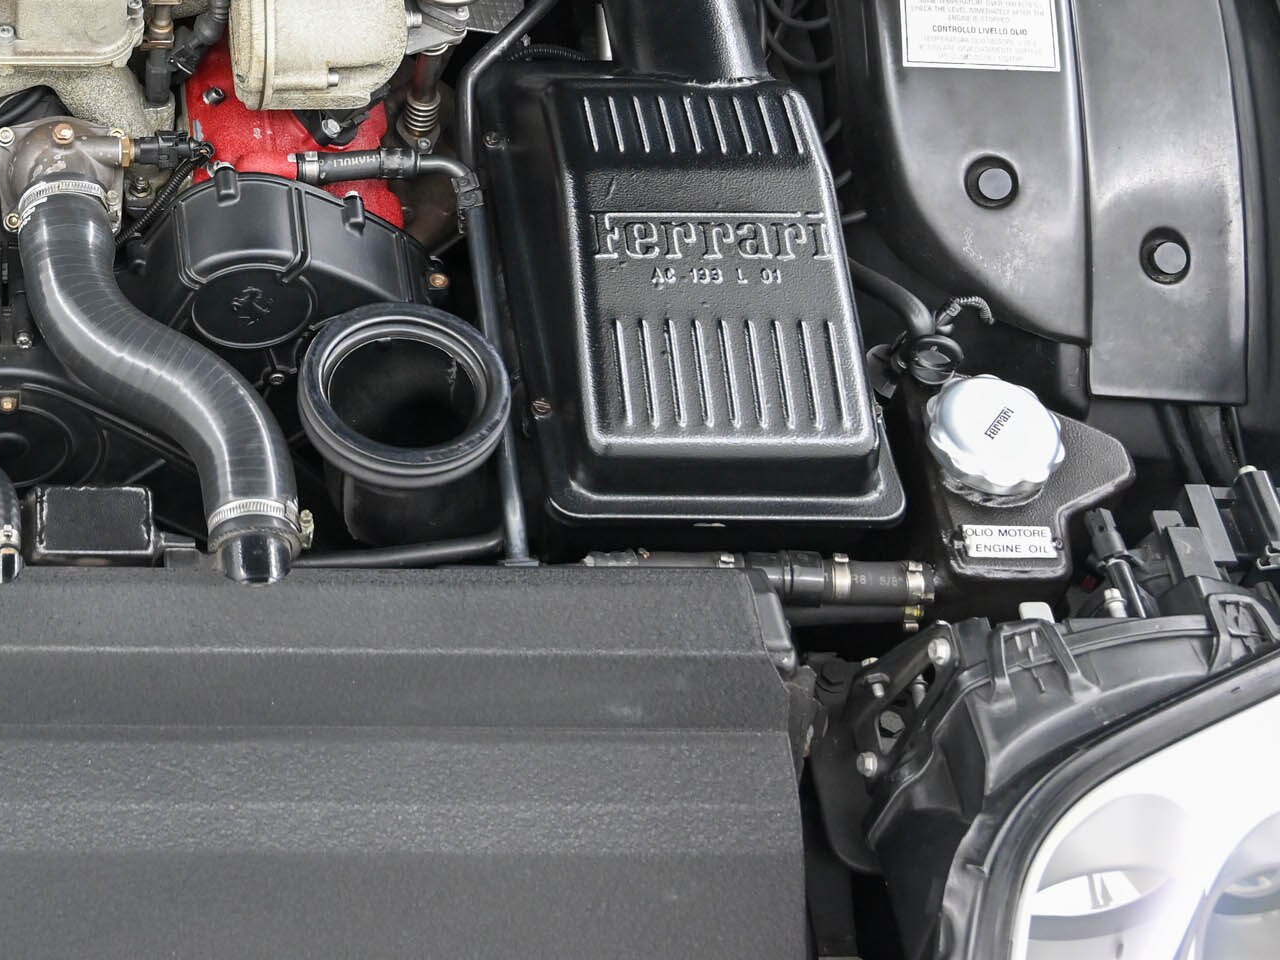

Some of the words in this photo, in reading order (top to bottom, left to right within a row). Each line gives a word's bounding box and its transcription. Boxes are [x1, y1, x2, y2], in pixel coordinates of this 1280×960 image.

[932, 24, 977, 34] CONTROLLO
[978, 26, 1008, 35] LIVELLO
[1010, 28, 1028, 36] OLIO
[333, 154, 375, 168] MANULI
[589, 209, 835, 260] Ferrari
[650, 266, 676, 283] AC
[690, 267, 723, 284] 133
[735, 267, 749, 284] L
[760, 268, 783, 284] 01
[984, 406, 1015, 440] Ferrari
[965, 527, 994, 537] OLIO
[998, 528, 1048, 538] MOTORE
[975, 543, 1022, 553] ENGINE
[1028, 544, 1049, 553] OIL
